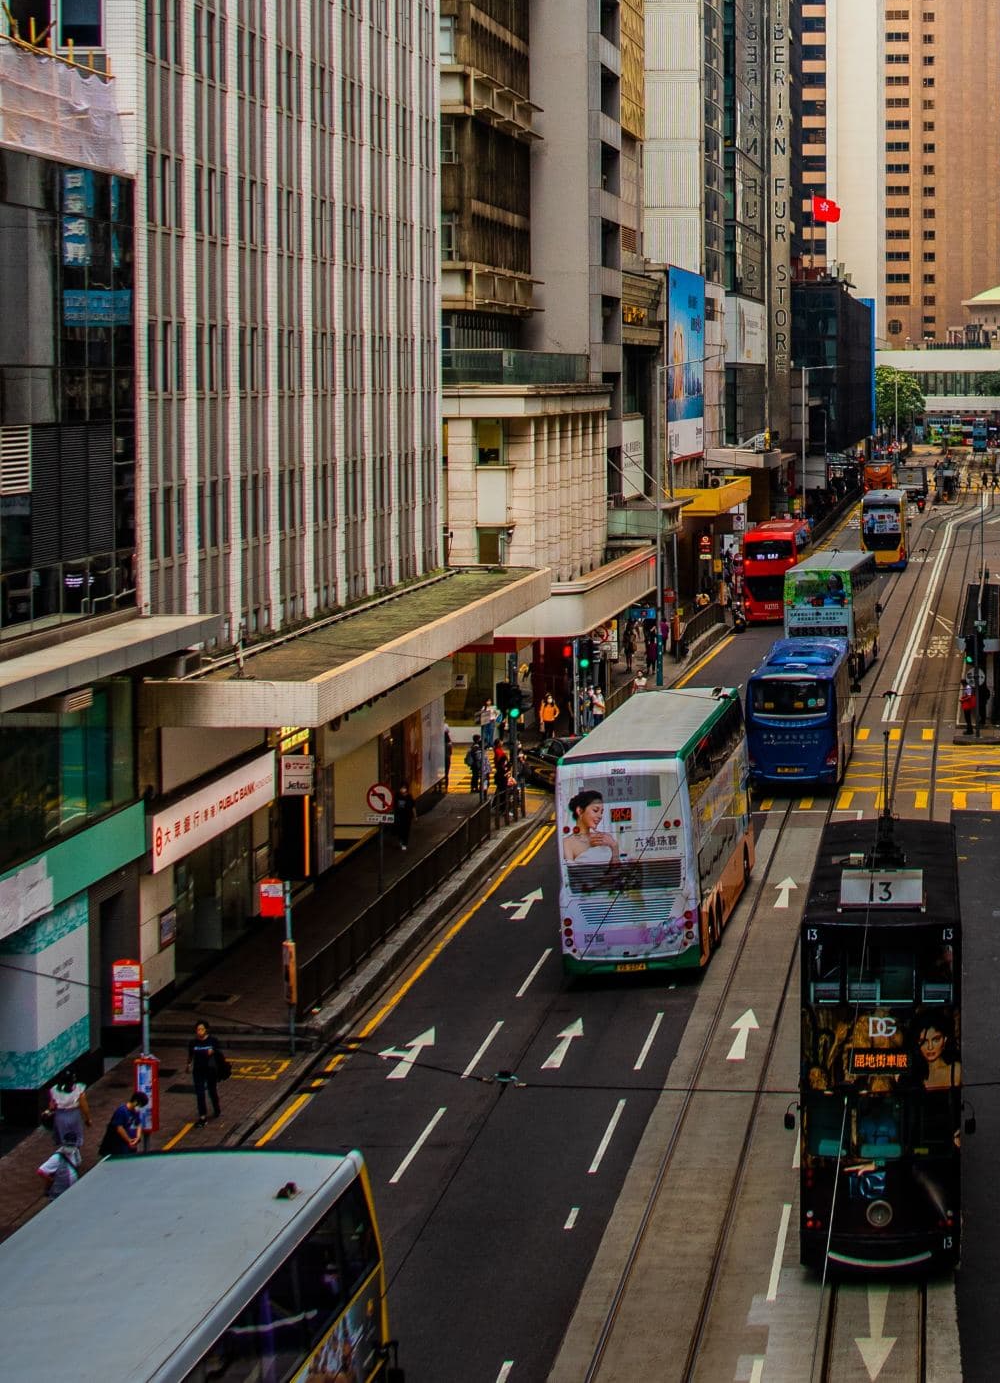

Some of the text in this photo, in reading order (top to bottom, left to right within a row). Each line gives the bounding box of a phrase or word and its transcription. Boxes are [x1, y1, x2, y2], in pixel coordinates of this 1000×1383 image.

[774, 178, 787, 243] FUR
[775, 265, 787, 375] STORE
[219, 791, 239, 811] PUBLIC
[240, 782, 256, 801] BANK
[635, 836, 678, 849] 六福珠寶
[869, 882, 892, 902] 13
[807, 929, 818, 940] 13
[942, 929, 953, 940] 13
[868, 1017, 897, 1037] DG
[943, 1236, 953, 1249] 13
